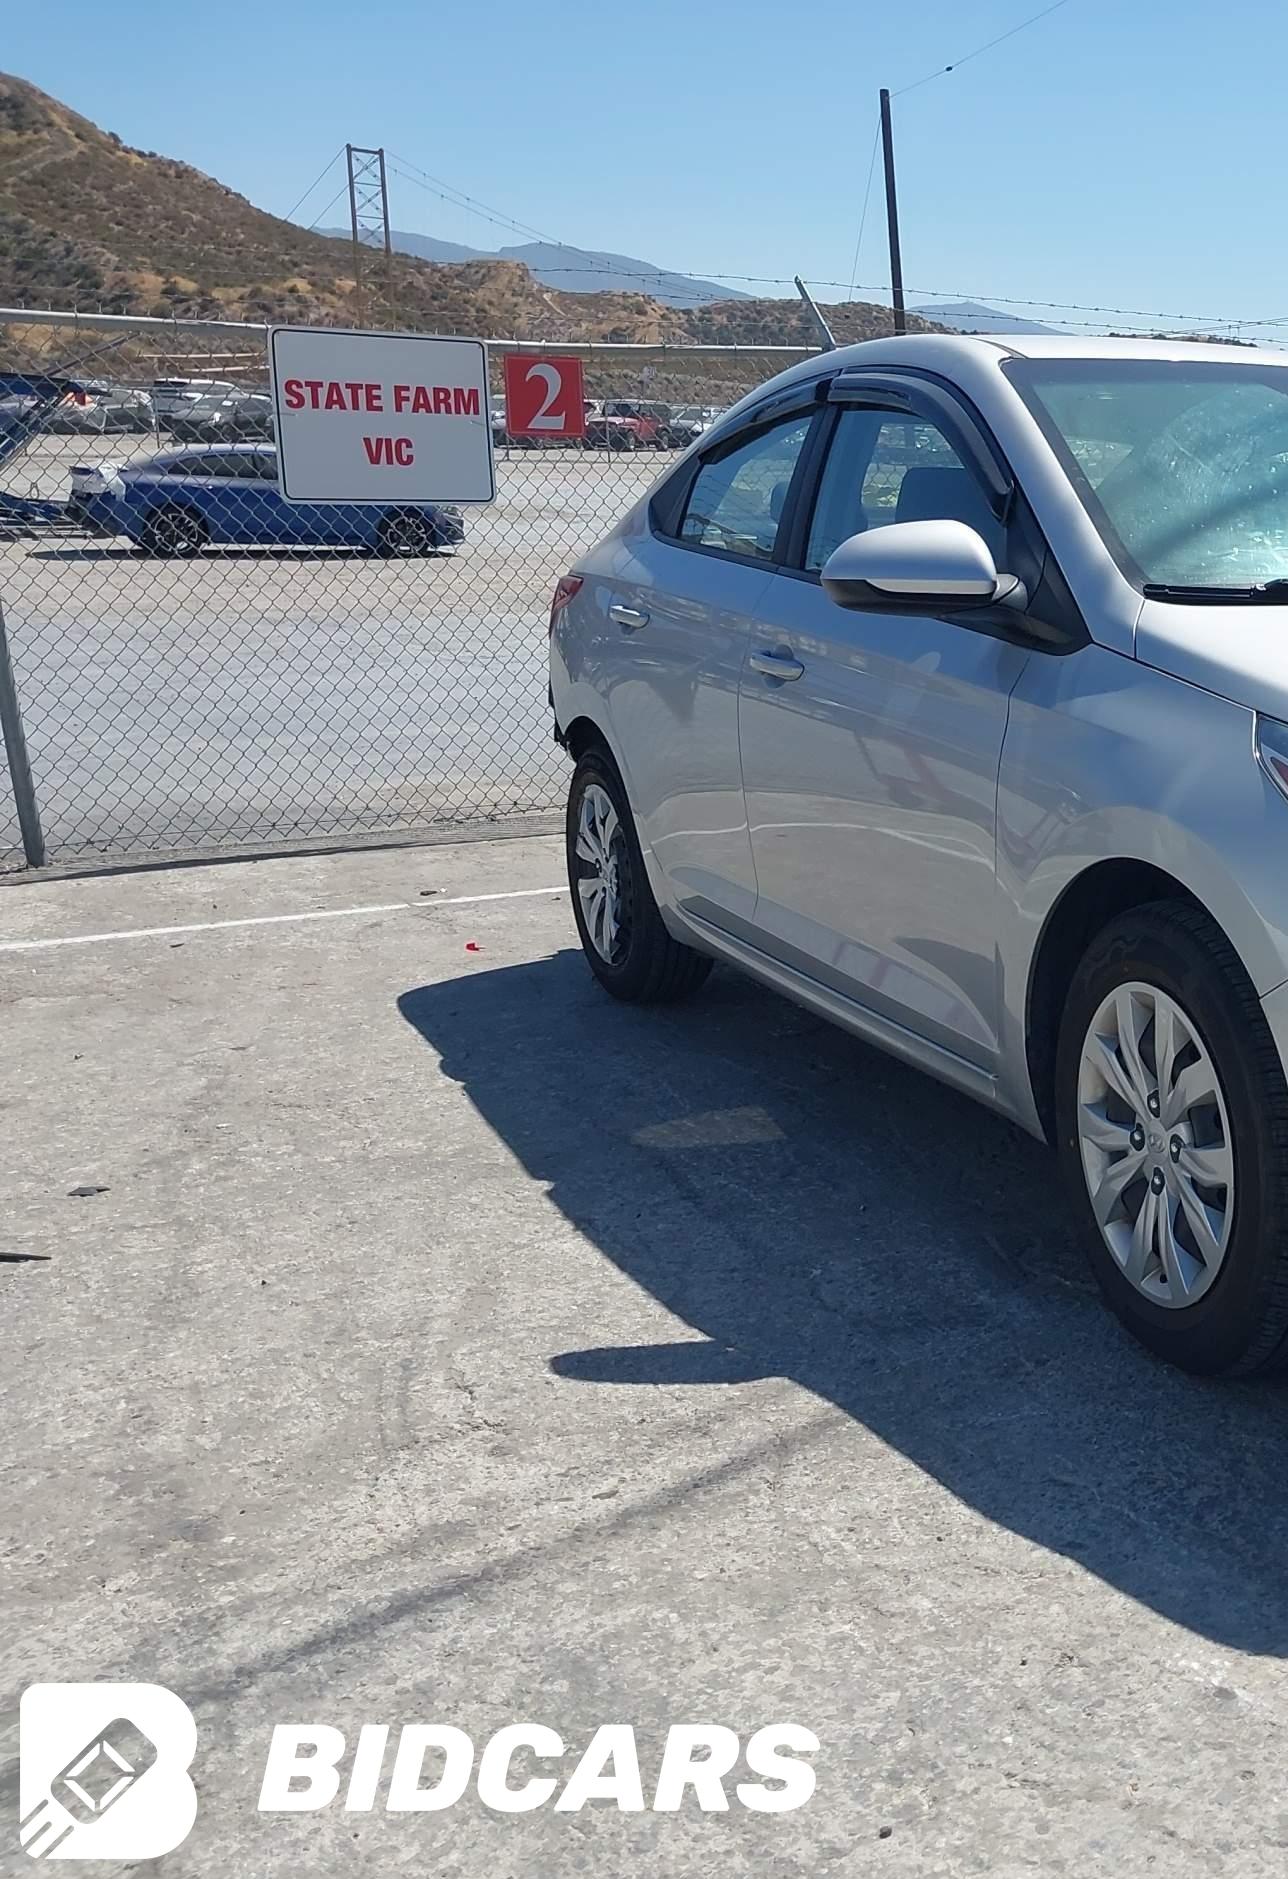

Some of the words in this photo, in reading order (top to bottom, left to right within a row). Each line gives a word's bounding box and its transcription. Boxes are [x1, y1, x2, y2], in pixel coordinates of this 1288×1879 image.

[284, 380, 384, 412] STATE
[394, 385, 480, 416] FARM
[525, 363, 566, 431] 2
[363, 437, 414, 466] VIC
